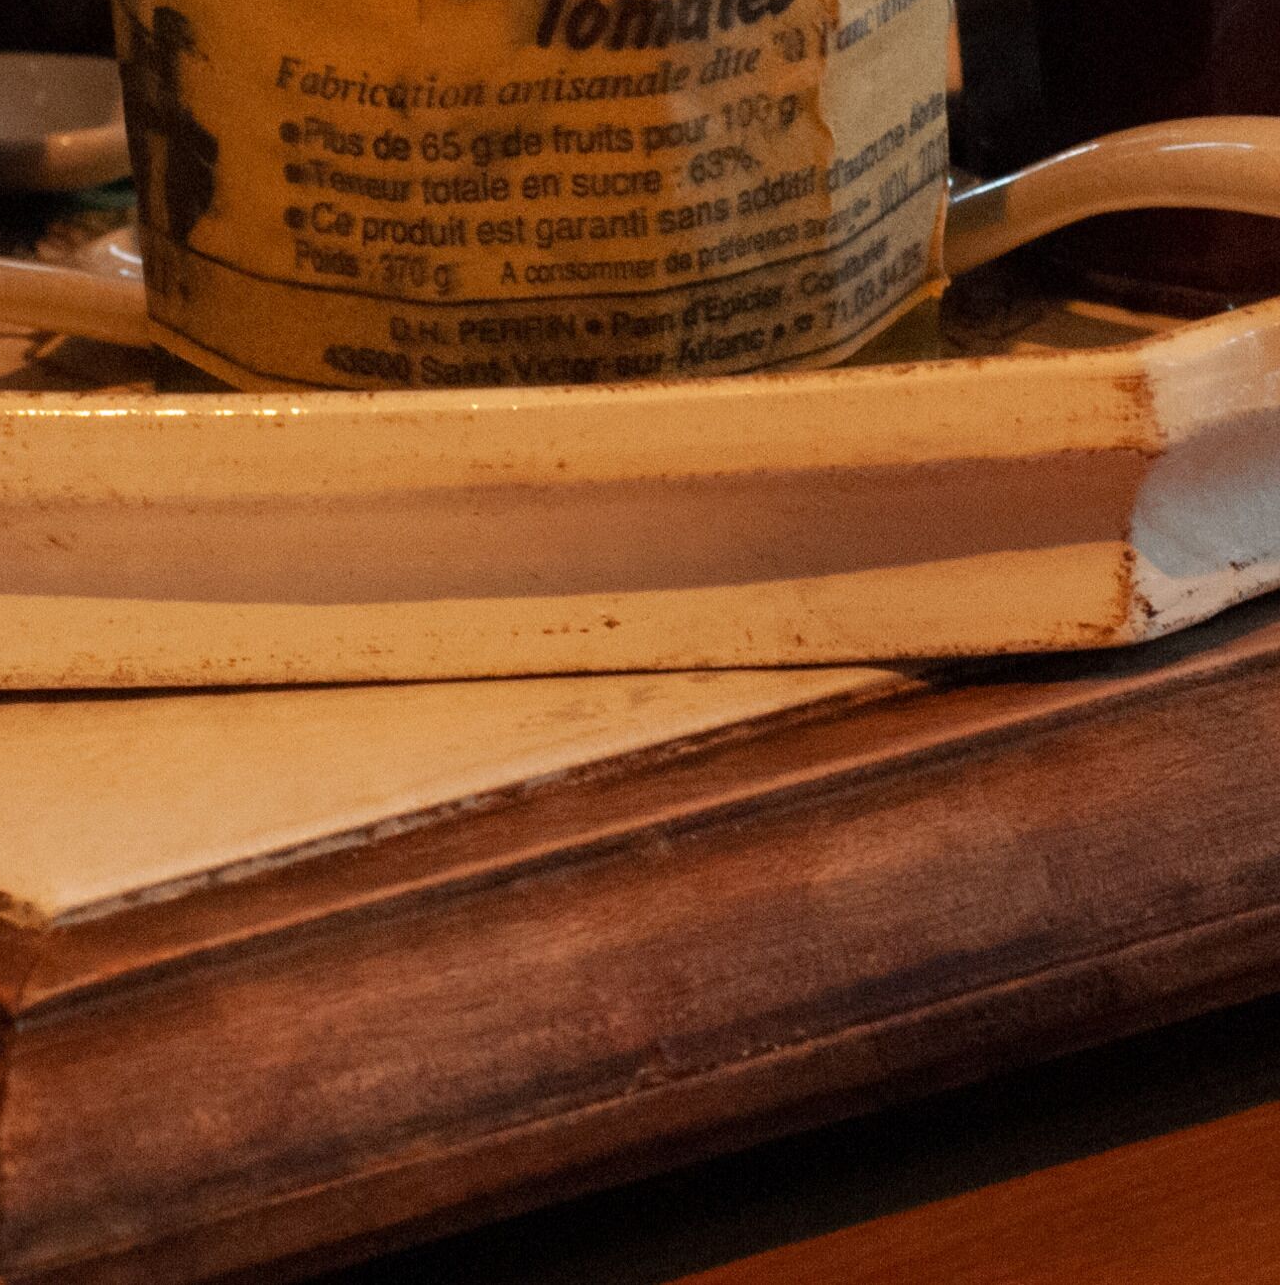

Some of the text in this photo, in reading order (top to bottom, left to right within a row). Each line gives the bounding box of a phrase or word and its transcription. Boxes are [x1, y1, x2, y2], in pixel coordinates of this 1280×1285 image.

[275, 56, 487, 109] Fabrication
[496, 61, 692, 107] artisanale
[699, 47, 762, 86] dite
[304, 115, 366, 159] Plus
[372, 129, 412, 162] de
[421, 130, 463, 163] 65
[470, 133, 494, 167] g
[500, 123, 544, 160] de
[551, 123, 635, 155] fruits
[640, 113, 712, 158] pour
[307, 158, 414, 205] Teneur
[422, 166, 511, 206] totale
[521, 171, 563, 201] en
[572, 169, 662, 200] sucre
[311, 201, 358, 238] Ce
[361, 211, 470, 247] produit
[476, 215, 527, 246] est
[535, 207, 650, 251] garanti
[656, 195, 731, 237] sans
[736, 165, 818, 217] additif
[432, 263, 455, 297] g
[524, 257, 659, 288] consommer
[664, 251, 693, 276] de
[697, 223, 800, 273] préférence
[458, 314, 578, 345] PERRIN
[609, 310, 676, 341] Pain
